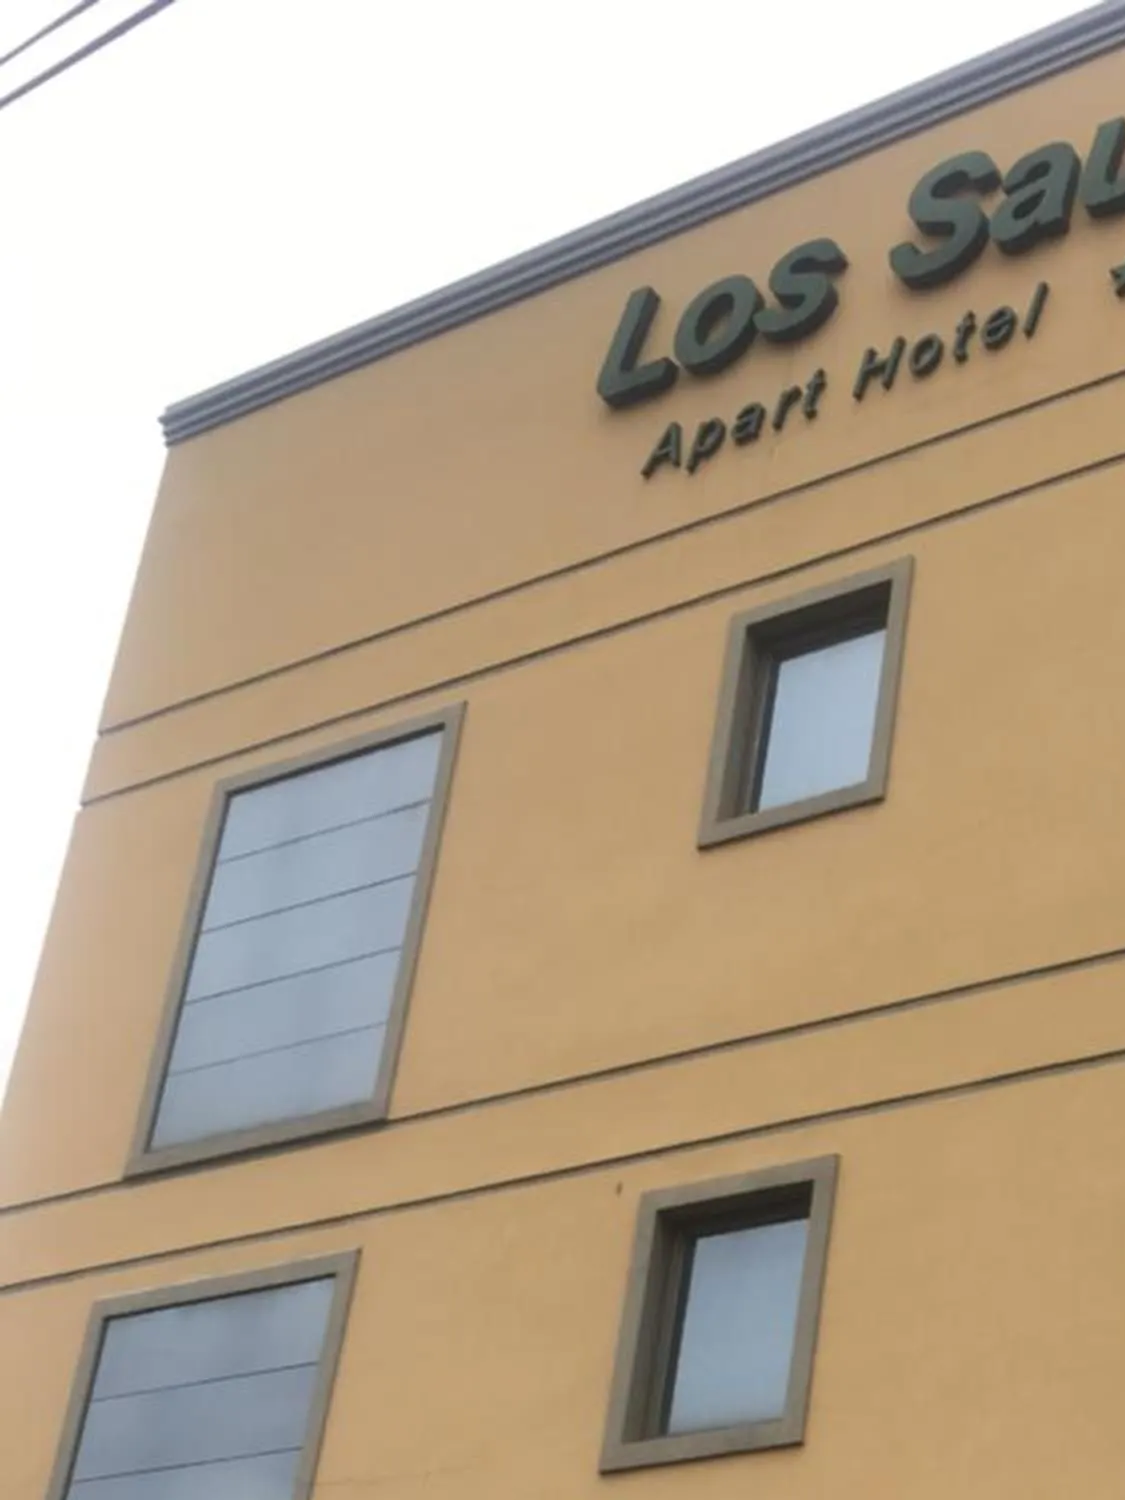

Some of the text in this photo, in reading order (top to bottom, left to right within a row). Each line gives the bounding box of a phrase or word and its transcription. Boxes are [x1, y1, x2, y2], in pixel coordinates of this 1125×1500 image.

[598, 236, 848, 410] Los
[640, 281, 1049, 479] Apart Hotel
